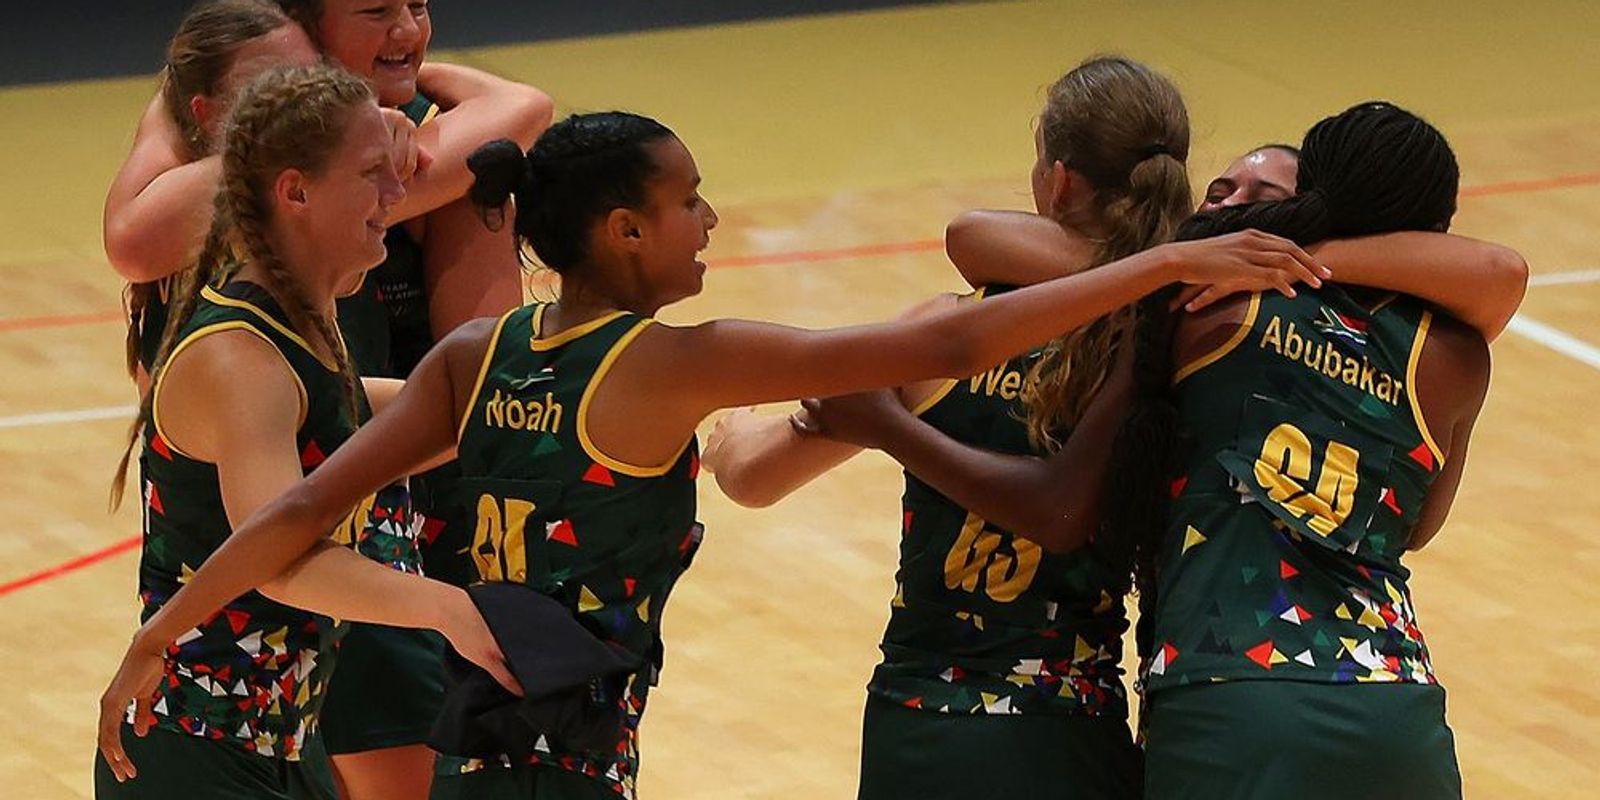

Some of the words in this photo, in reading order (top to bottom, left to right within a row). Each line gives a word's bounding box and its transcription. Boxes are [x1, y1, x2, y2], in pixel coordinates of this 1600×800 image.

[969, 358, 1027, 400] We
[1260, 315, 1403, 406] Abubakar
[485, 388, 563, 433] Noah
